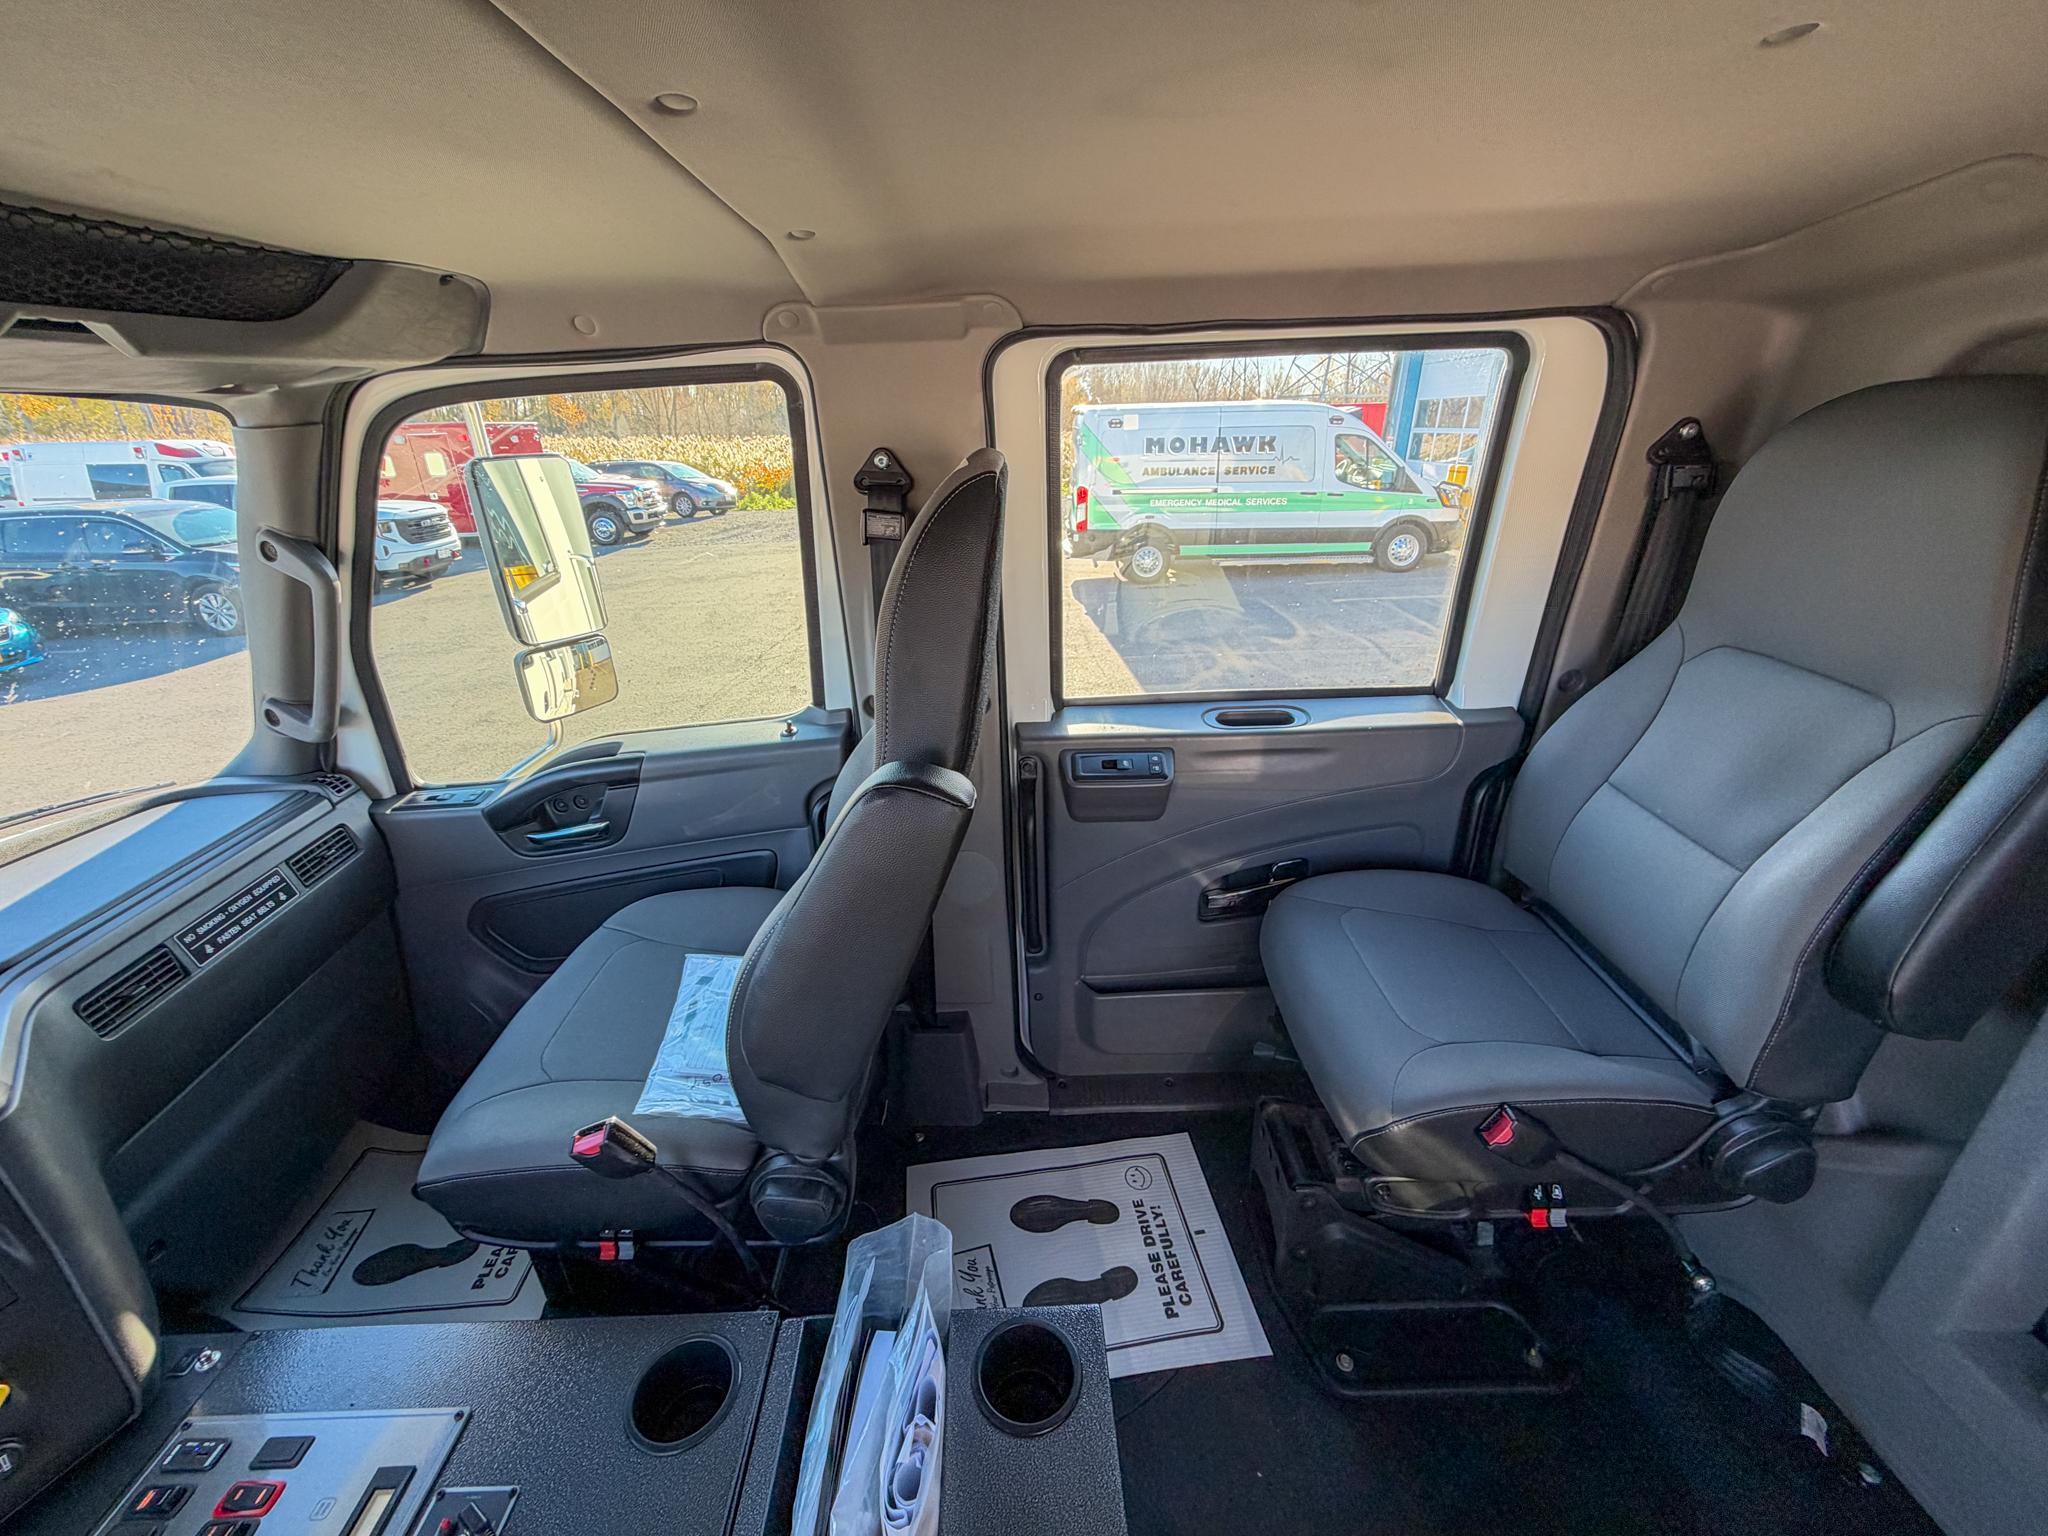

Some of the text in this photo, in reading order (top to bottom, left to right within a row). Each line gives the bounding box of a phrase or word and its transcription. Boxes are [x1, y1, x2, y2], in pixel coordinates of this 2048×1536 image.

[1144, 435, 1277, 455] MOHAWK
[1142, 465, 1276, 477] AMBULANCE SERVICE
[1150, 499, 1201, 507] EMERGENCY
[1246, 498, 1288, 506] SERVICES
[183, 875, 281, 943] NO SMOKING OXYGEN EQUIPPED
[216, 900, 276, 944] FASTEN SEAT BELTS
[290, 1243, 335, 1287] Thank
[324, 1218, 354, 1240] You
[471, 1247, 504, 1290] PLEA
[958, 1256, 982, 1283] You
[1132, 1199, 1179, 1319] PLEASE DRIVE
[1150, 1205, 1193, 1306] CAREFULLY!
